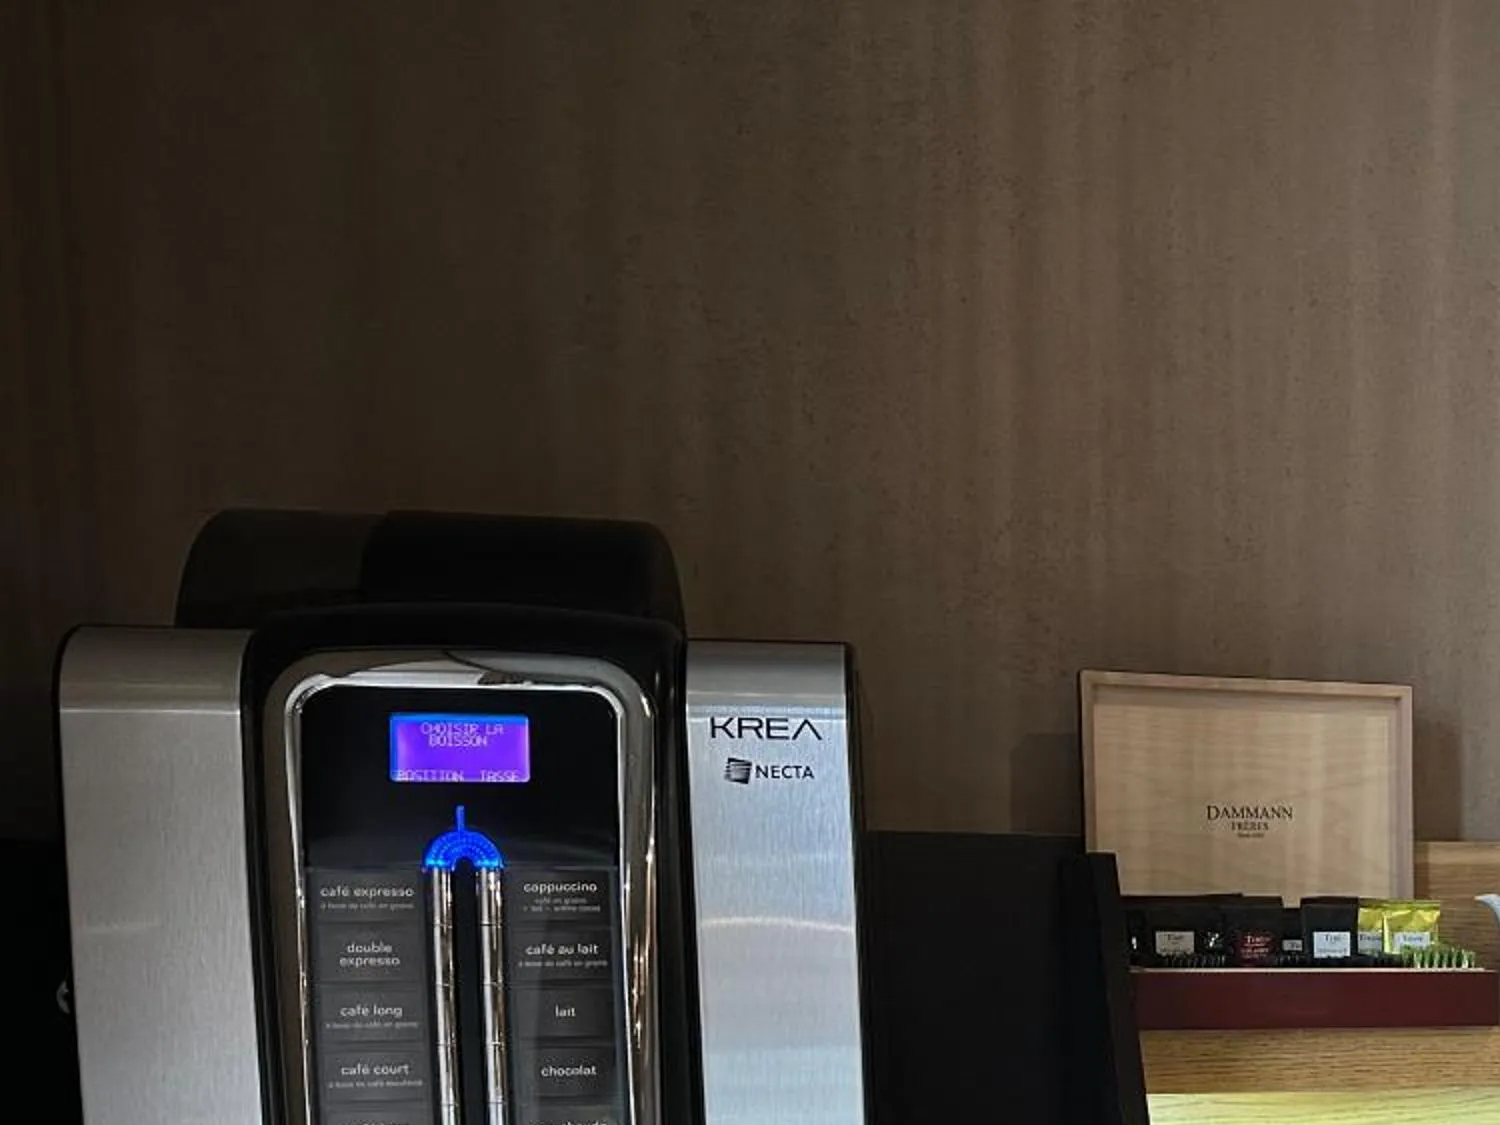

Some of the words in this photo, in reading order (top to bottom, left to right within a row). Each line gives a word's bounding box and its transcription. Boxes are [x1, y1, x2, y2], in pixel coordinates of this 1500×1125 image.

[485, 723, 504, 735] LA
[755, 765, 815, 779] NECTA
[1207, 805, 1293, 820] DAMMANN
[320, 884, 350, 897] café
[353, 887, 415, 900] expresso
[523, 882, 598, 894] cappuccino
[346, 941, 393, 953] double
[525, 943, 555, 955] café
[558, 945, 574, 955] au
[577, 943, 599, 955] lait
[339, 956, 401, 968] expresso
[340, 1004, 370, 1017] café
[373, 1004, 403, 1019] long
[555, 1004, 576, 1017] lait
[341, 1063, 371, 1075] café
[373, 1063, 409, 1075] court
[540, 1064, 597, 1077] chocolat
